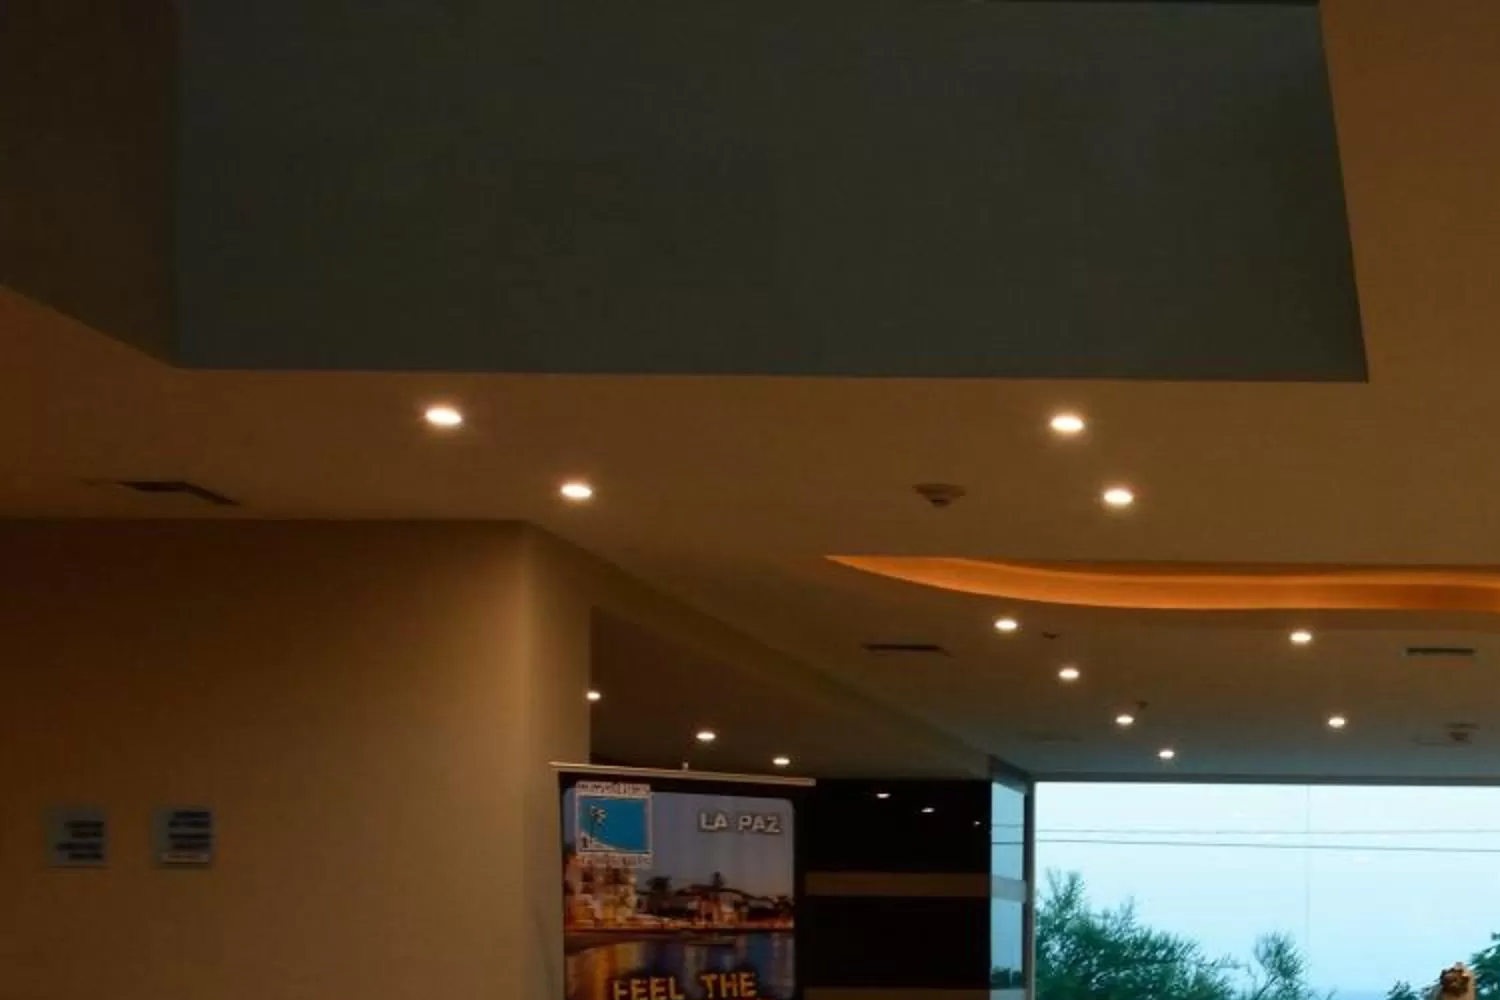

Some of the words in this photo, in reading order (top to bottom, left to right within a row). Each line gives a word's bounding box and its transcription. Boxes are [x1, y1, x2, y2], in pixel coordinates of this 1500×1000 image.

[700, 811, 728, 832] LA
[738, 815, 781, 834] PAZ
[700, 970, 758, 1000] THE
